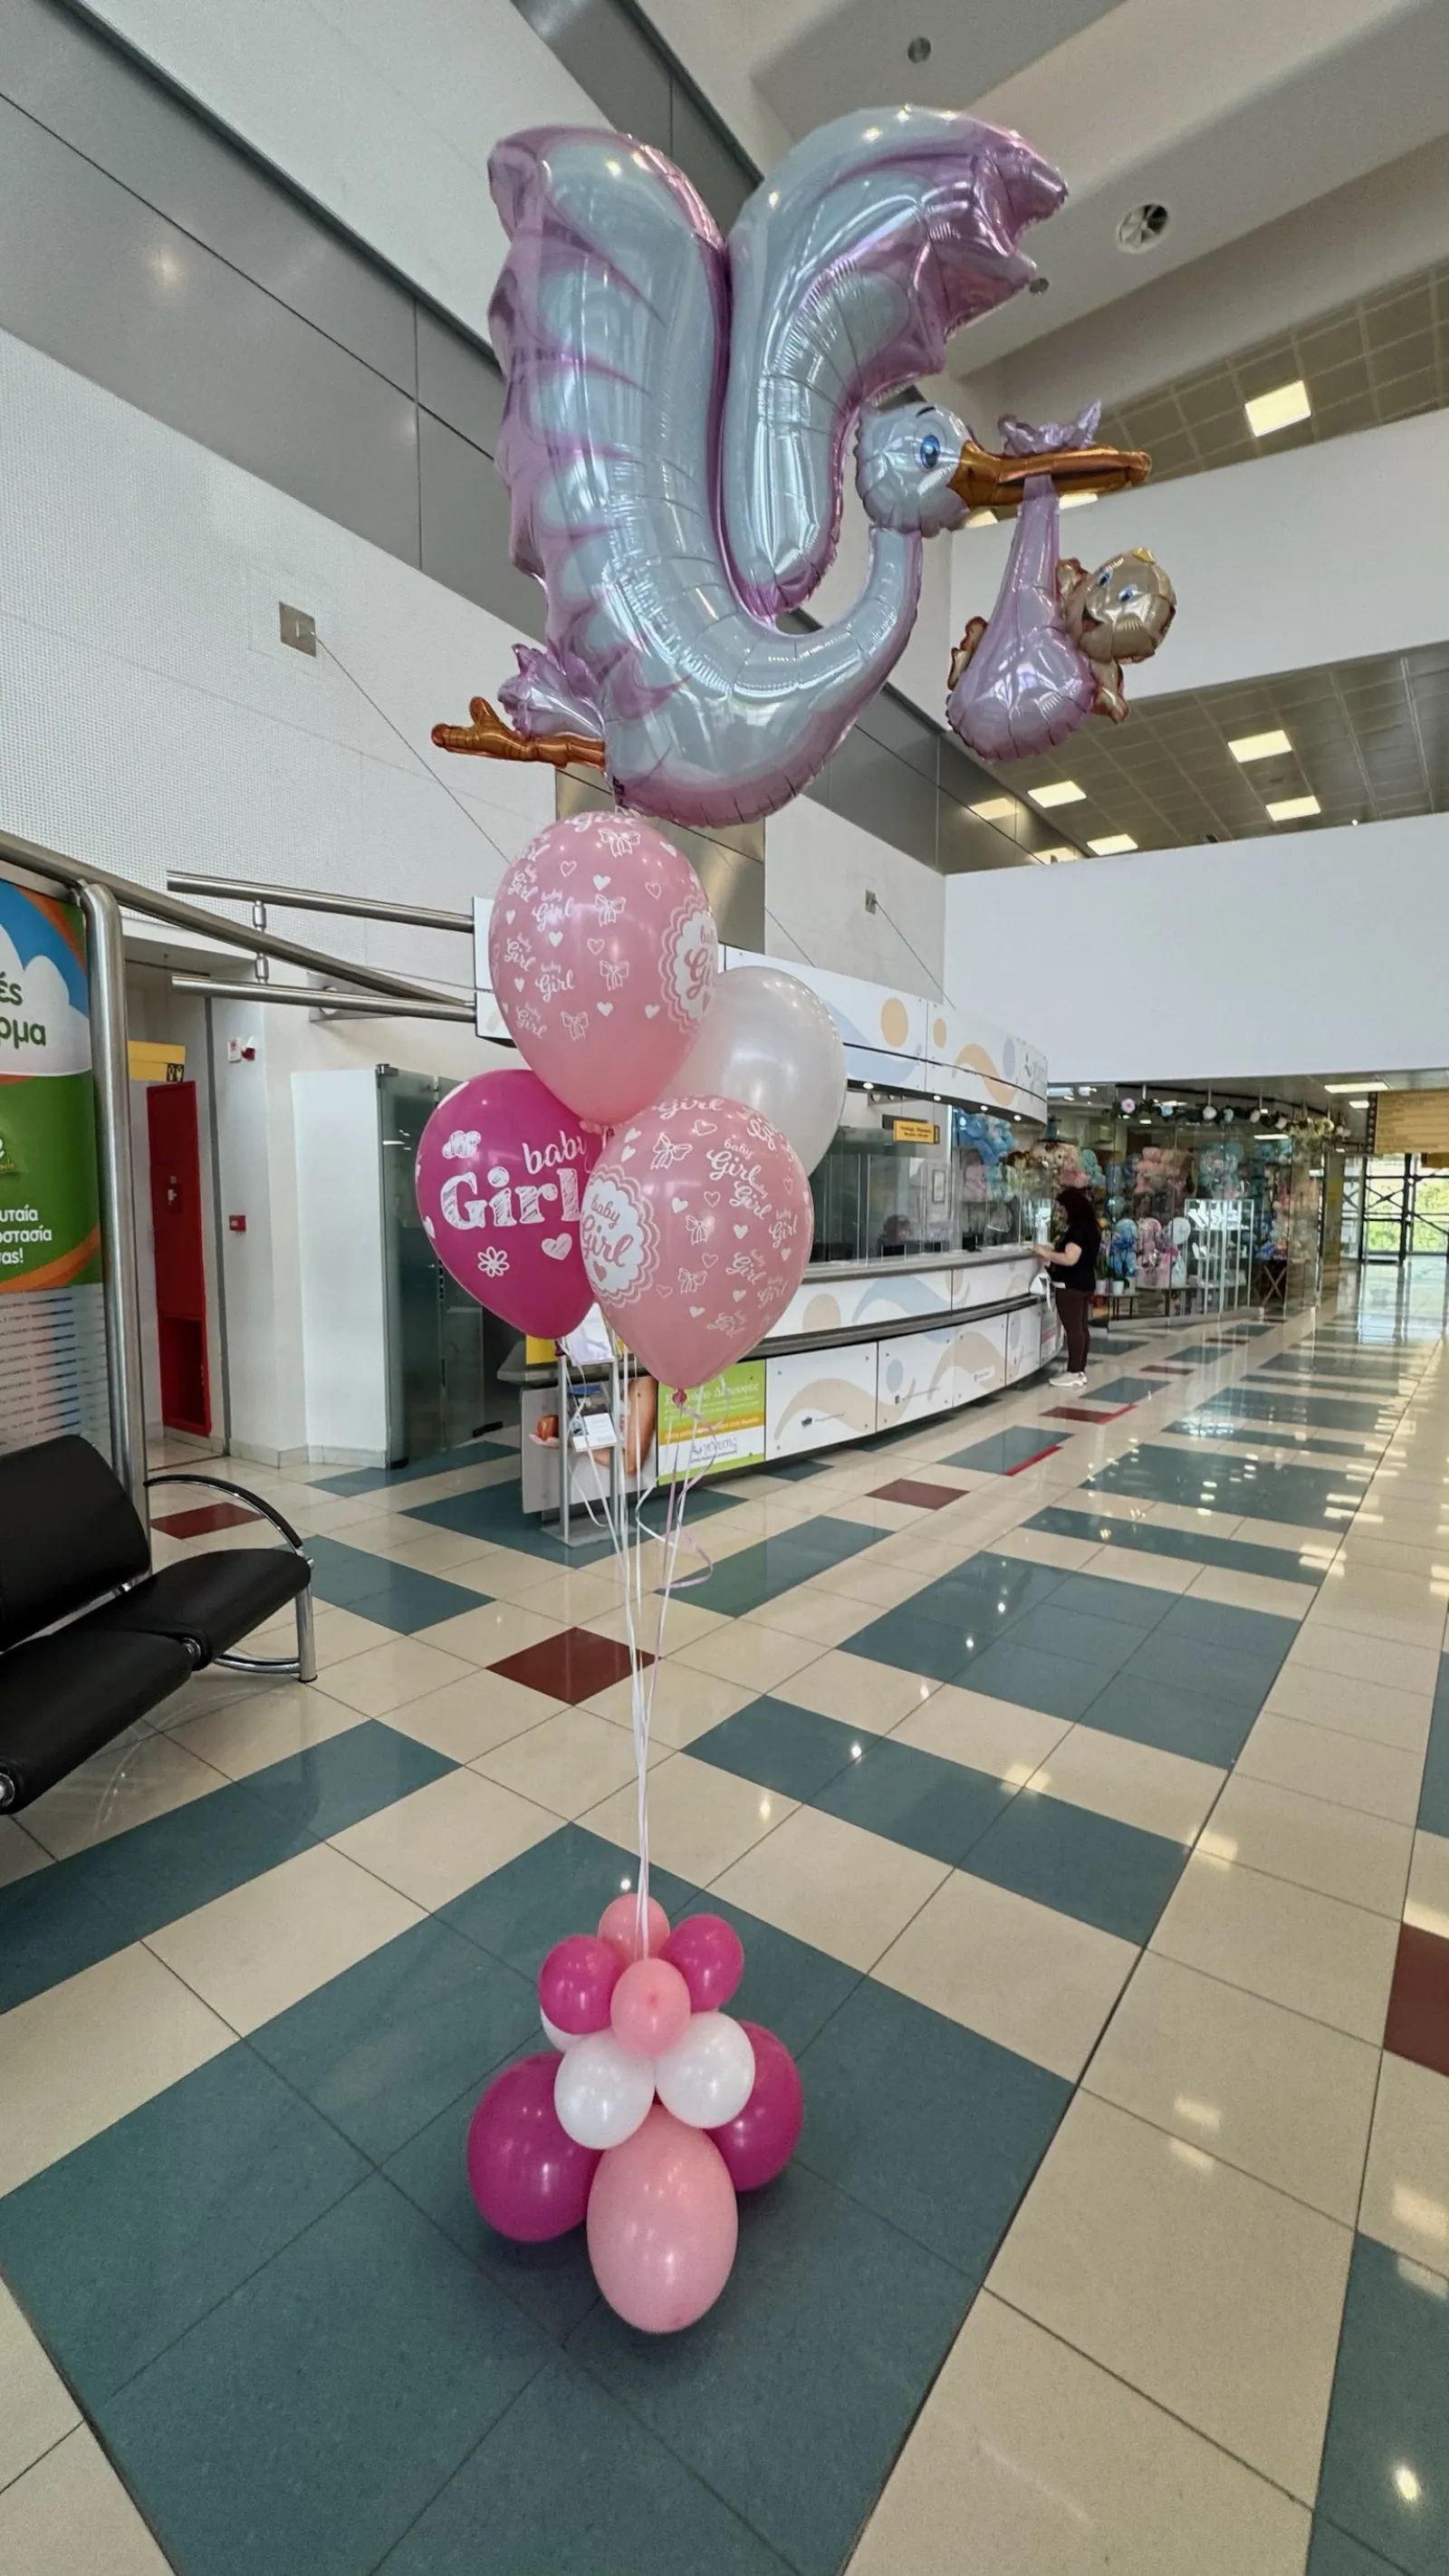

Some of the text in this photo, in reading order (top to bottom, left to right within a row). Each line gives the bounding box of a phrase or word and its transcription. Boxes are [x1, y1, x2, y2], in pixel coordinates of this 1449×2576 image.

[532, 896, 574, 932] Girl
[504, 937, 536, 972] Girl
[534, 969, 575, 1003] Girl
[515, 1004, 548, 1040] Girl
[522, 1129, 594, 1175] baby
[705, 1149, 763, 1182] Girl
[724, 1138, 755, 1160] baby
[440, 1166, 582, 1230] Girl
[591, 1194, 620, 1229] baby
[729, 1180, 772, 1220] Girl
[581, 1214, 635, 1268] Girl
[769, 1215, 799, 1249] Girl
[724, 1252, 767, 1286] Girl
